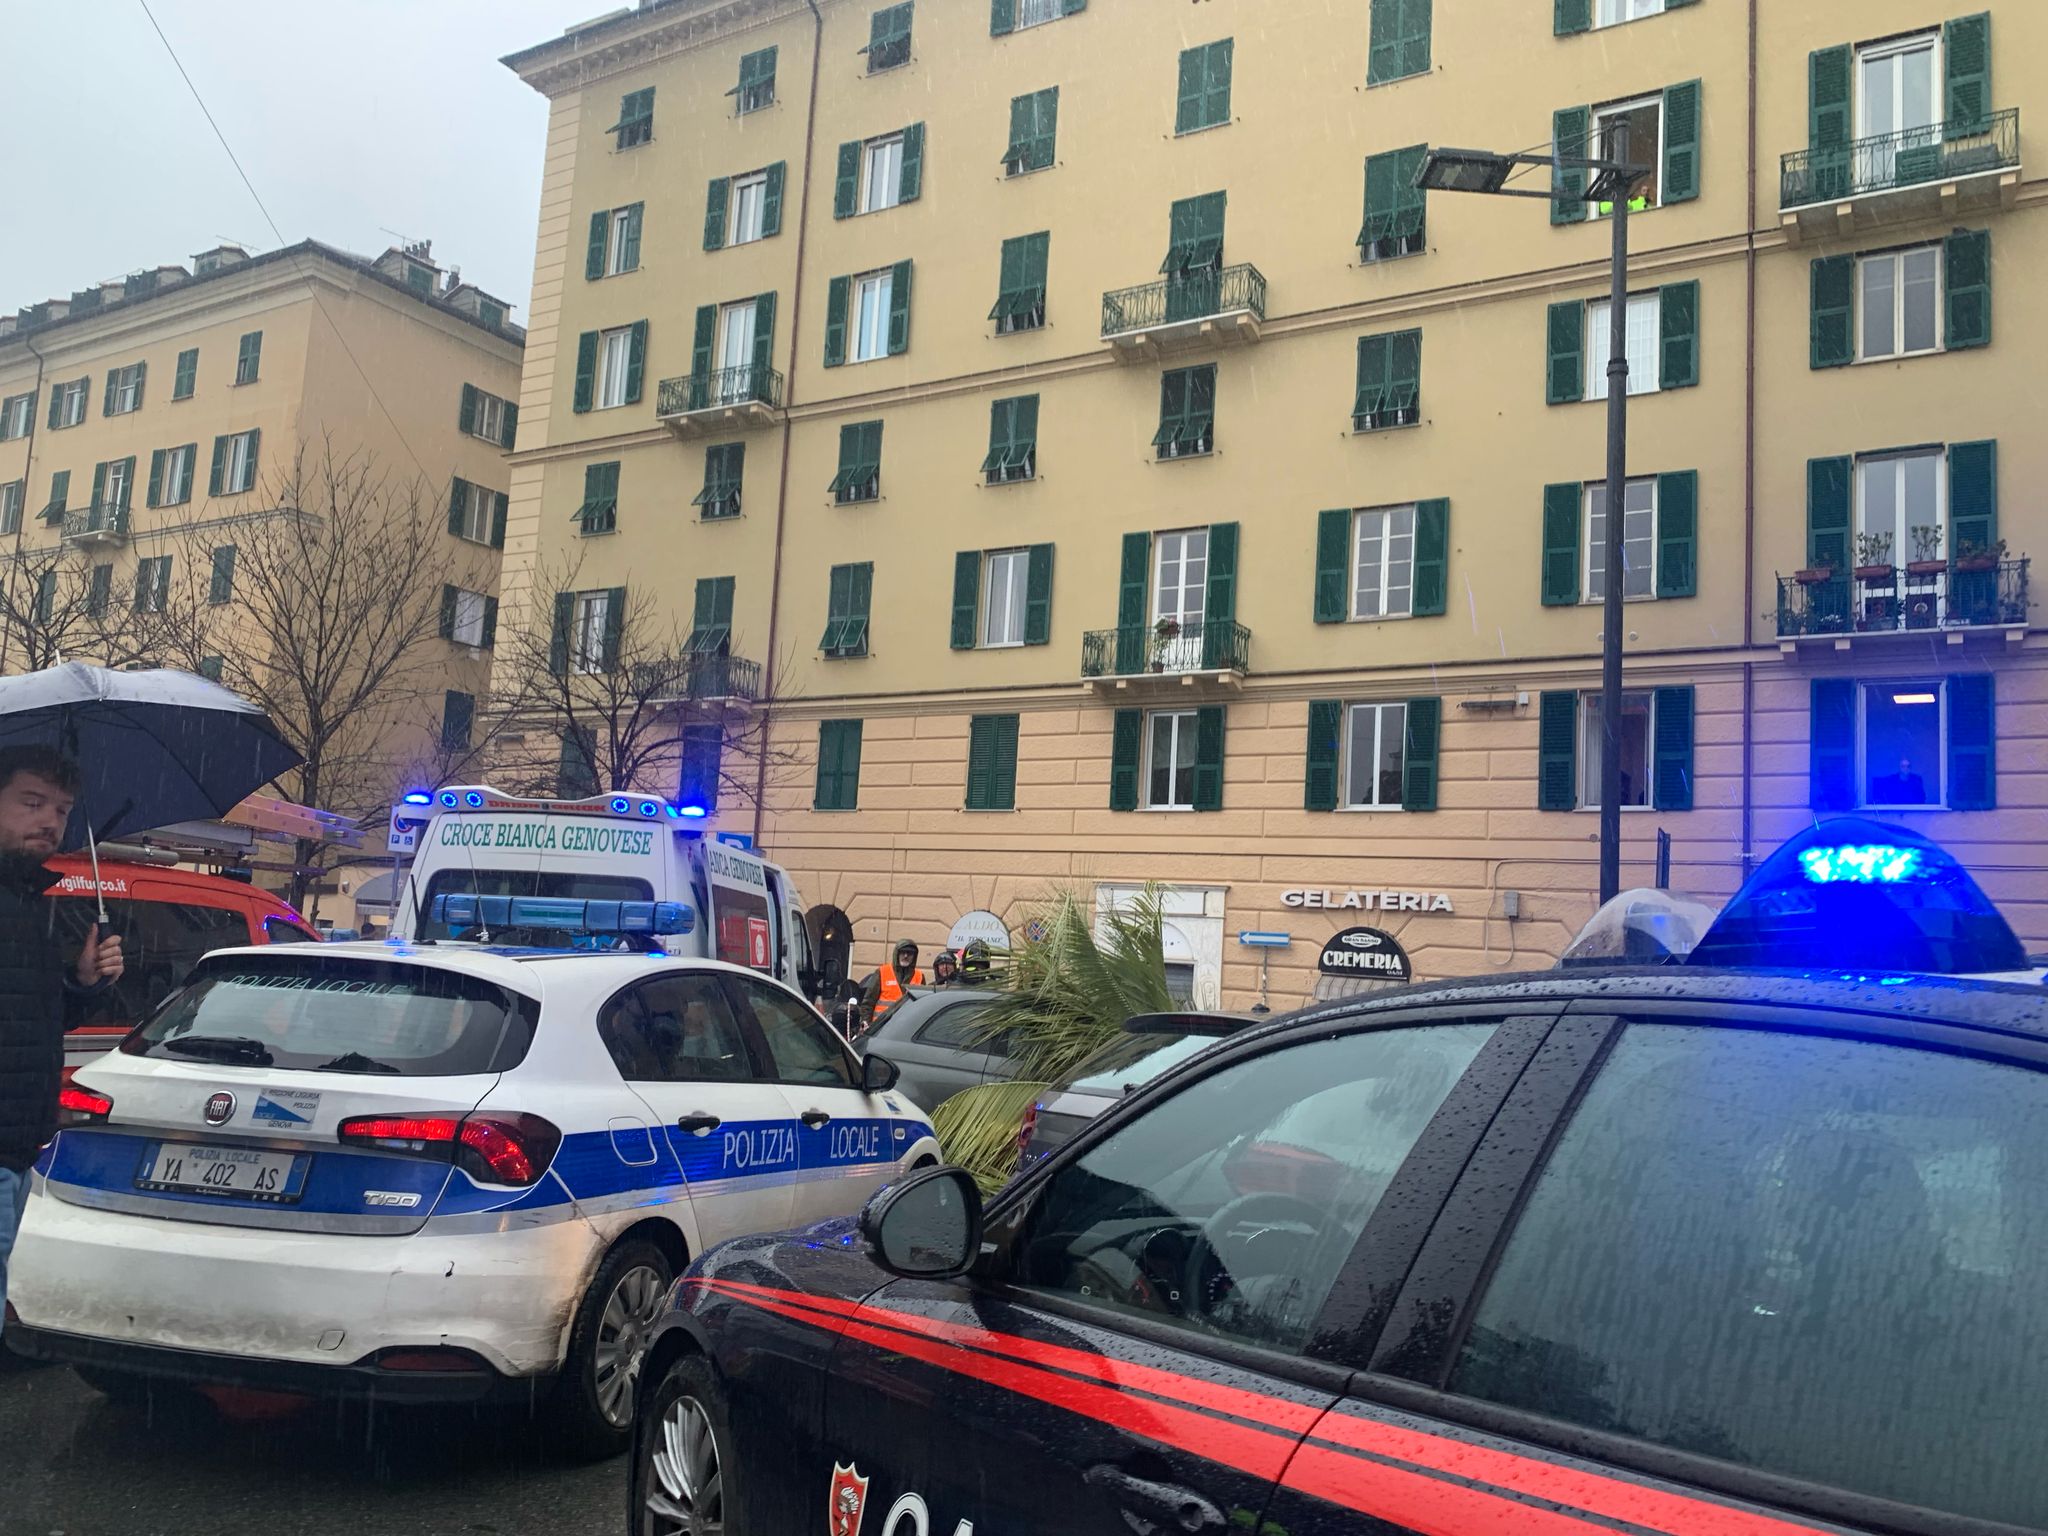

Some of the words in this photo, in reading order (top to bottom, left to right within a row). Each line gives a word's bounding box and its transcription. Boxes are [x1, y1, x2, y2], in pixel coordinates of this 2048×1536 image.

[441, 822, 494, 847] CROCE
[495, 823, 558, 849] BIANCA
[562, 826, 654, 855] GENOVESE
[729, 856, 764, 886] GENOVESE
[1279, 889, 1454, 912] GELATERIA
[1322, 950, 1403, 970] CREMERIA
[226, 975, 312, 990] POLIZIA
[312, 978, 408, 998] LOCALE
[209, 1100, 230, 1116] FIAT
[189, 1148, 221, 1161] POLIZIA
[225, 1151, 262, 1165] LOCALE
[723, 1128, 794, 1169] POLIZIA
[830, 1125, 880, 1159] LOCALE
[162, 1158, 183, 1182] YA
[202, 1162, 236, 1187] 402
[254, 1166, 279, 1191] AS
